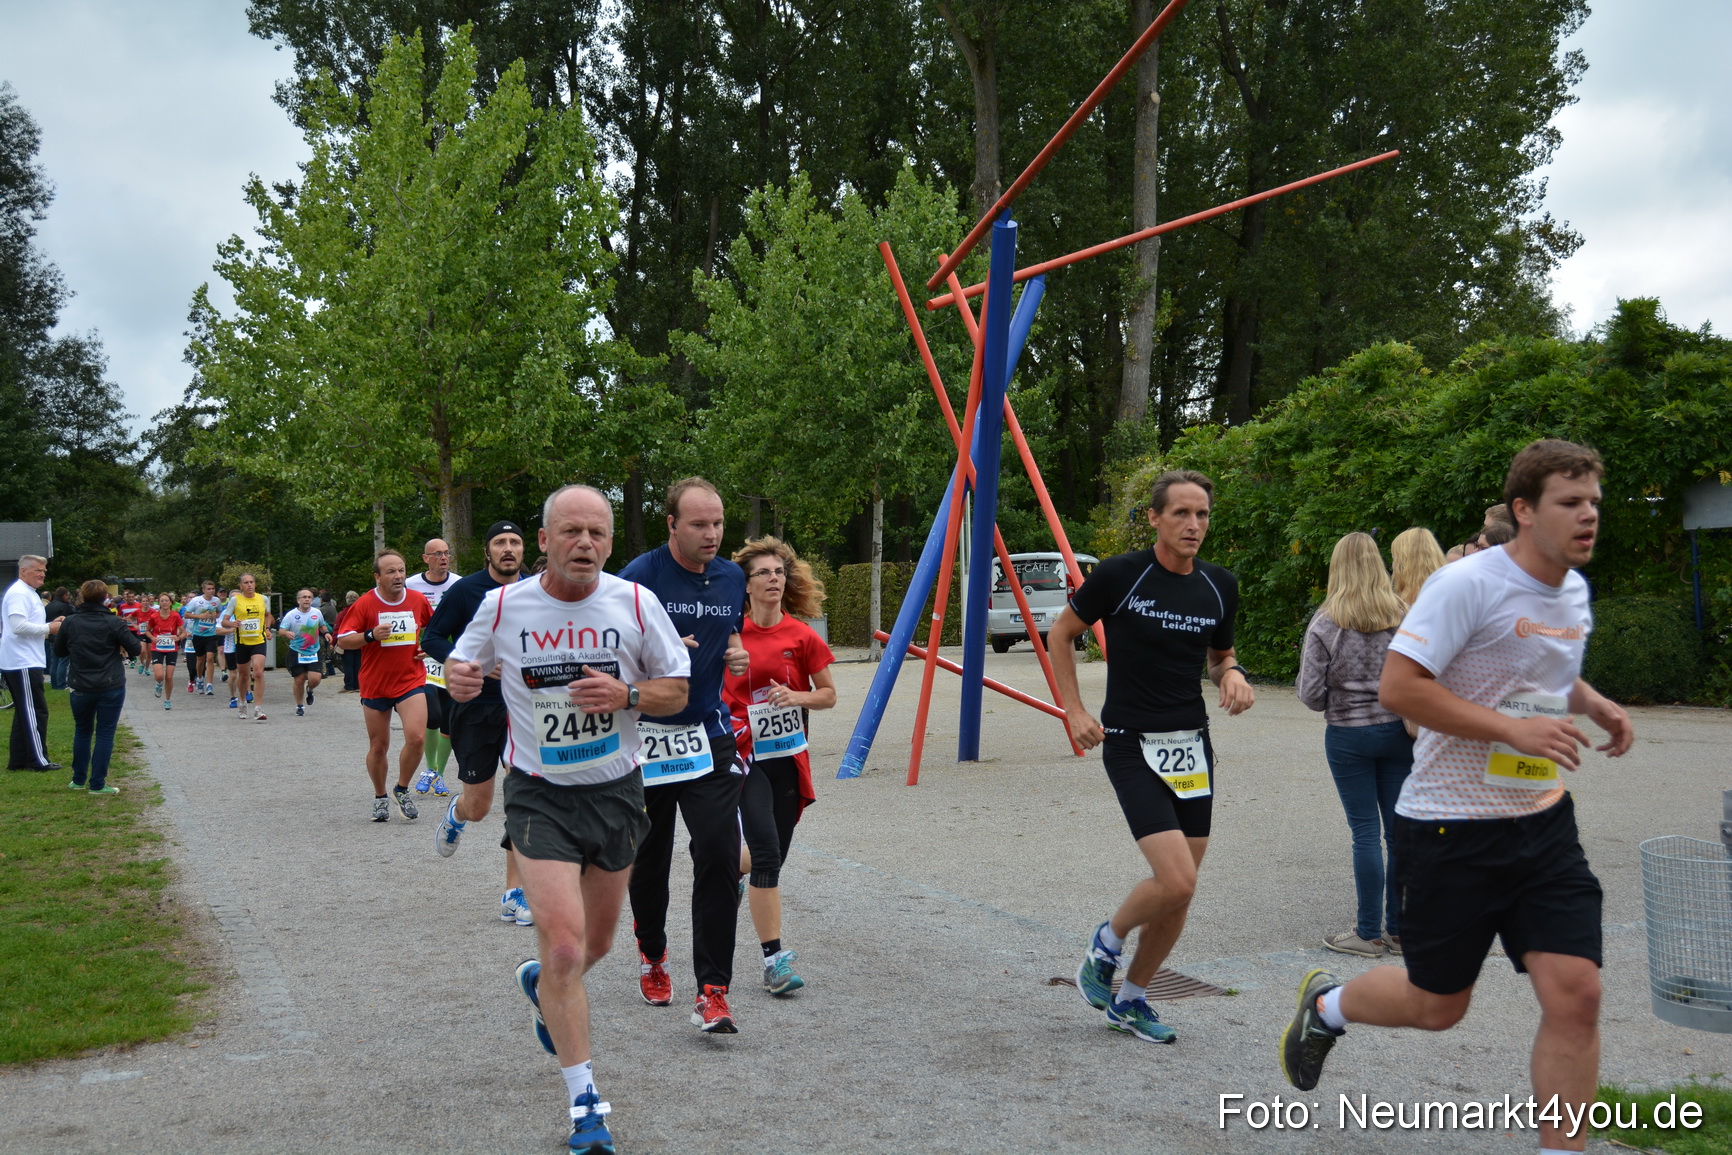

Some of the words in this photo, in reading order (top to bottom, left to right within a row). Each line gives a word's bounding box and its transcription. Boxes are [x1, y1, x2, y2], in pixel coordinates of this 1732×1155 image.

[1128, 596, 1155, 612] Vegan
[1141, 607, 1181, 621] Laufen
[1185, 615, 1216, 626] gegen
[1162, 620, 1201, 633] Leiden
[519, 621, 620, 654] twinn
[521, 651, 566, 665] Consulting
[569, 652, 576, 660] &
[530, 666, 563, 677] TWINN
[565, 665, 579, 673] der
[544, 674, 574, 683] persönlich
[535, 701, 563, 709] PARTL
[750, 708, 771, 716] PARTL
[1500, 700, 1530, 712] PARTL
[543, 712, 614, 742] 2449
[758, 709, 800, 738] 2553
[644, 730, 703, 759] 2155
[775, 738, 796, 750] Birgit
[557, 742, 607, 762] Willfried
[1157, 747, 1196, 773] 225
[661, 761, 695, 774] Marcus
